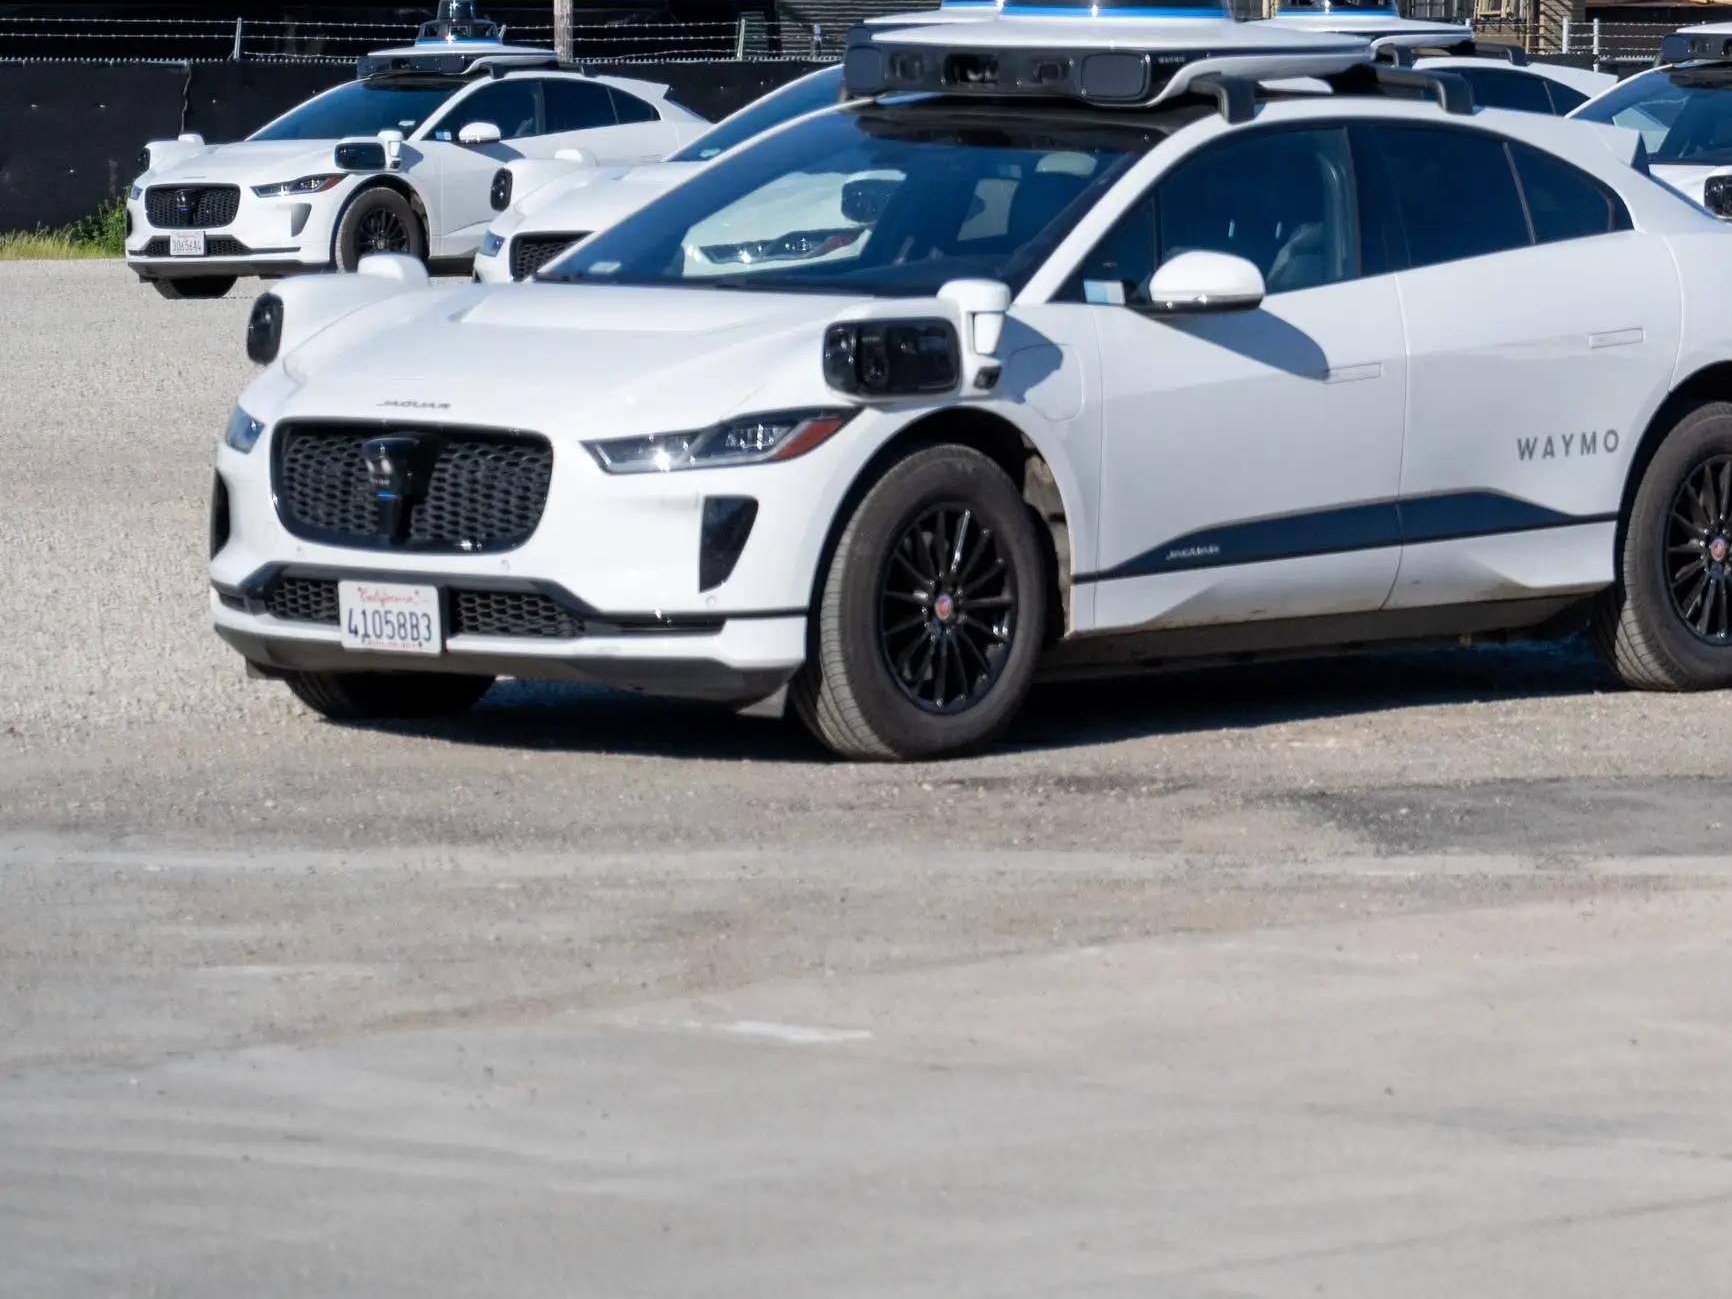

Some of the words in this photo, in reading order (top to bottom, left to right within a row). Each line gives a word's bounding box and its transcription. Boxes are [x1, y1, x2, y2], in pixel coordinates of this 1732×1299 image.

[376, 399, 452, 410] JAGUAR
[1516, 428, 1620, 462] WAYMO
[357, 585, 418, 607] California
[347, 607, 433, 643] 41058B3
